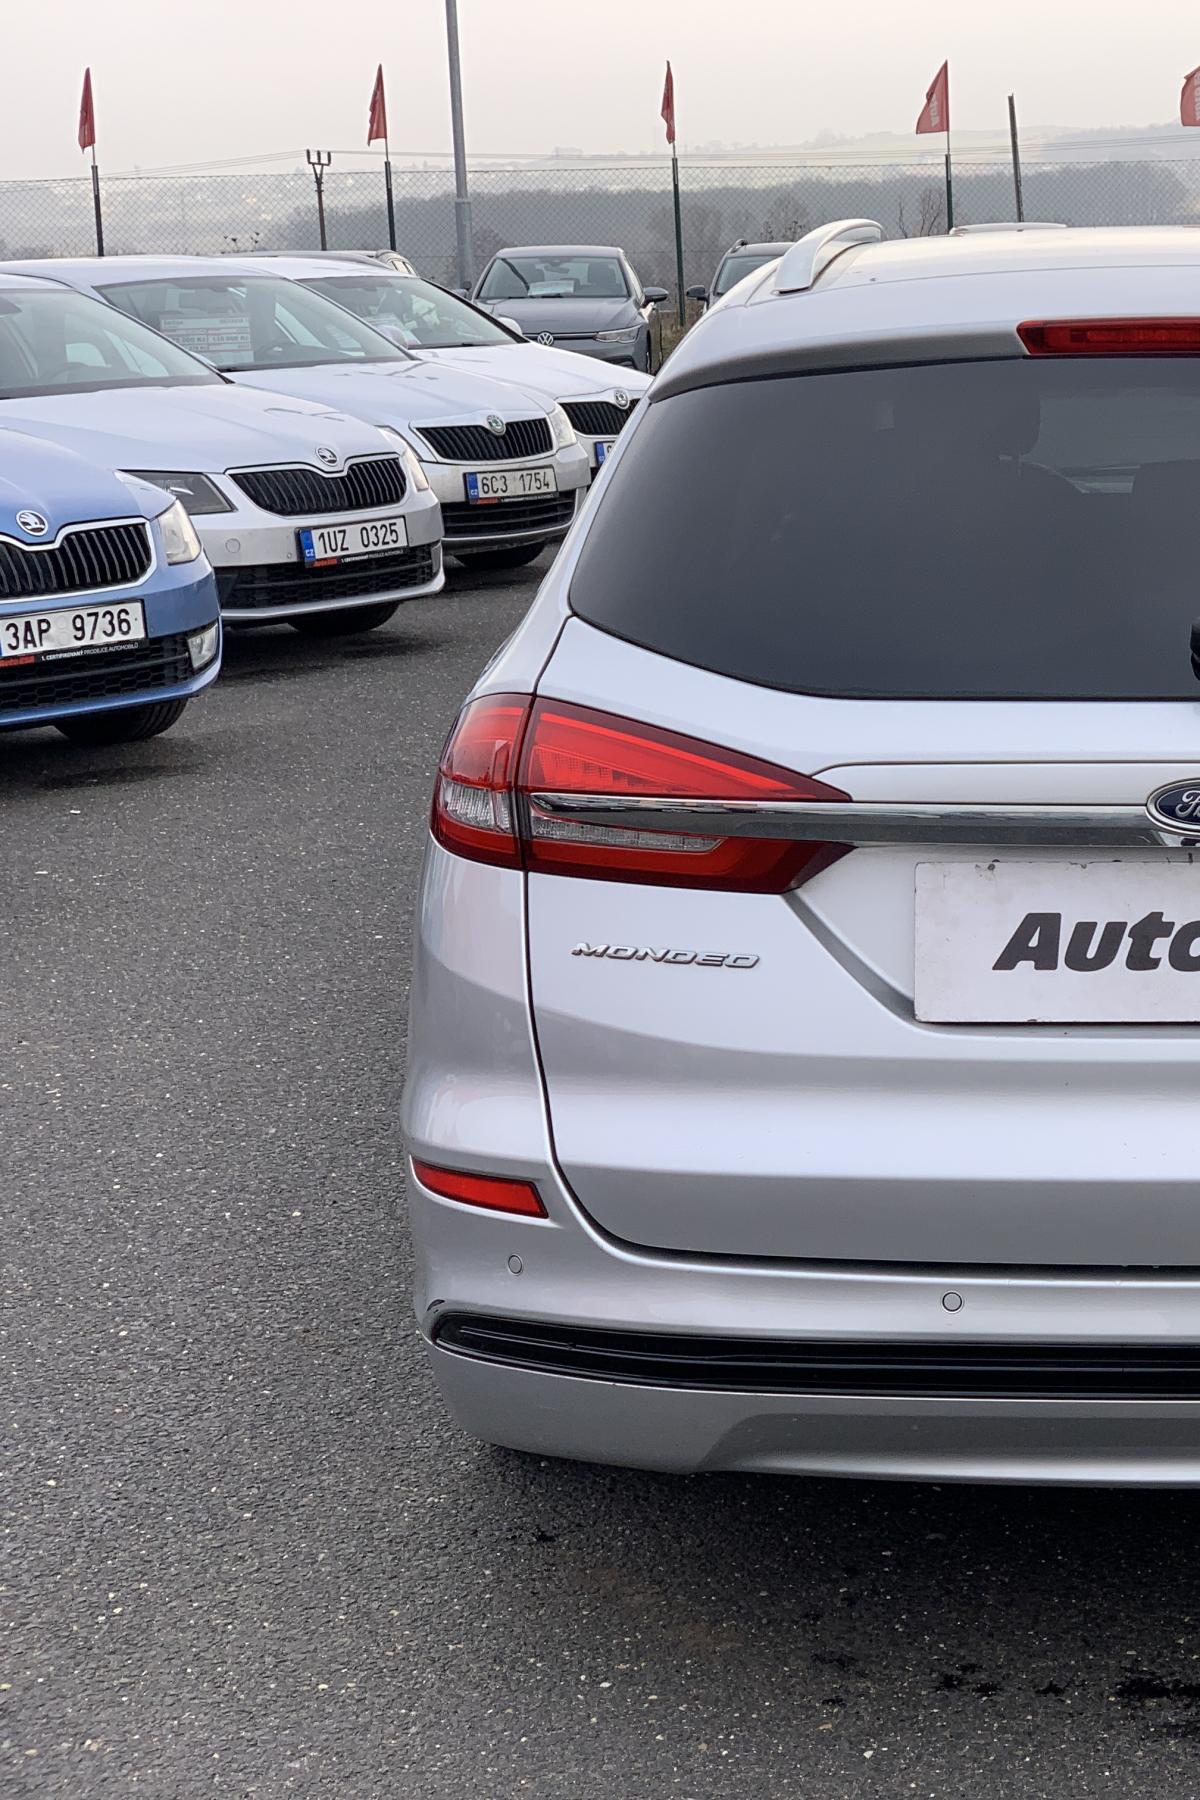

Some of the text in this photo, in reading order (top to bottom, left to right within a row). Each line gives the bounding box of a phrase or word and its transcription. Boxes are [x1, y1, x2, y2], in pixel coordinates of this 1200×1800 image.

[481, 472, 550, 494] 6C3 1754
[318, 522, 399, 554] 1UZ 0325
[5, 608, 131, 650] 3AP 9736
[571, 942, 760, 969] MONDEO
